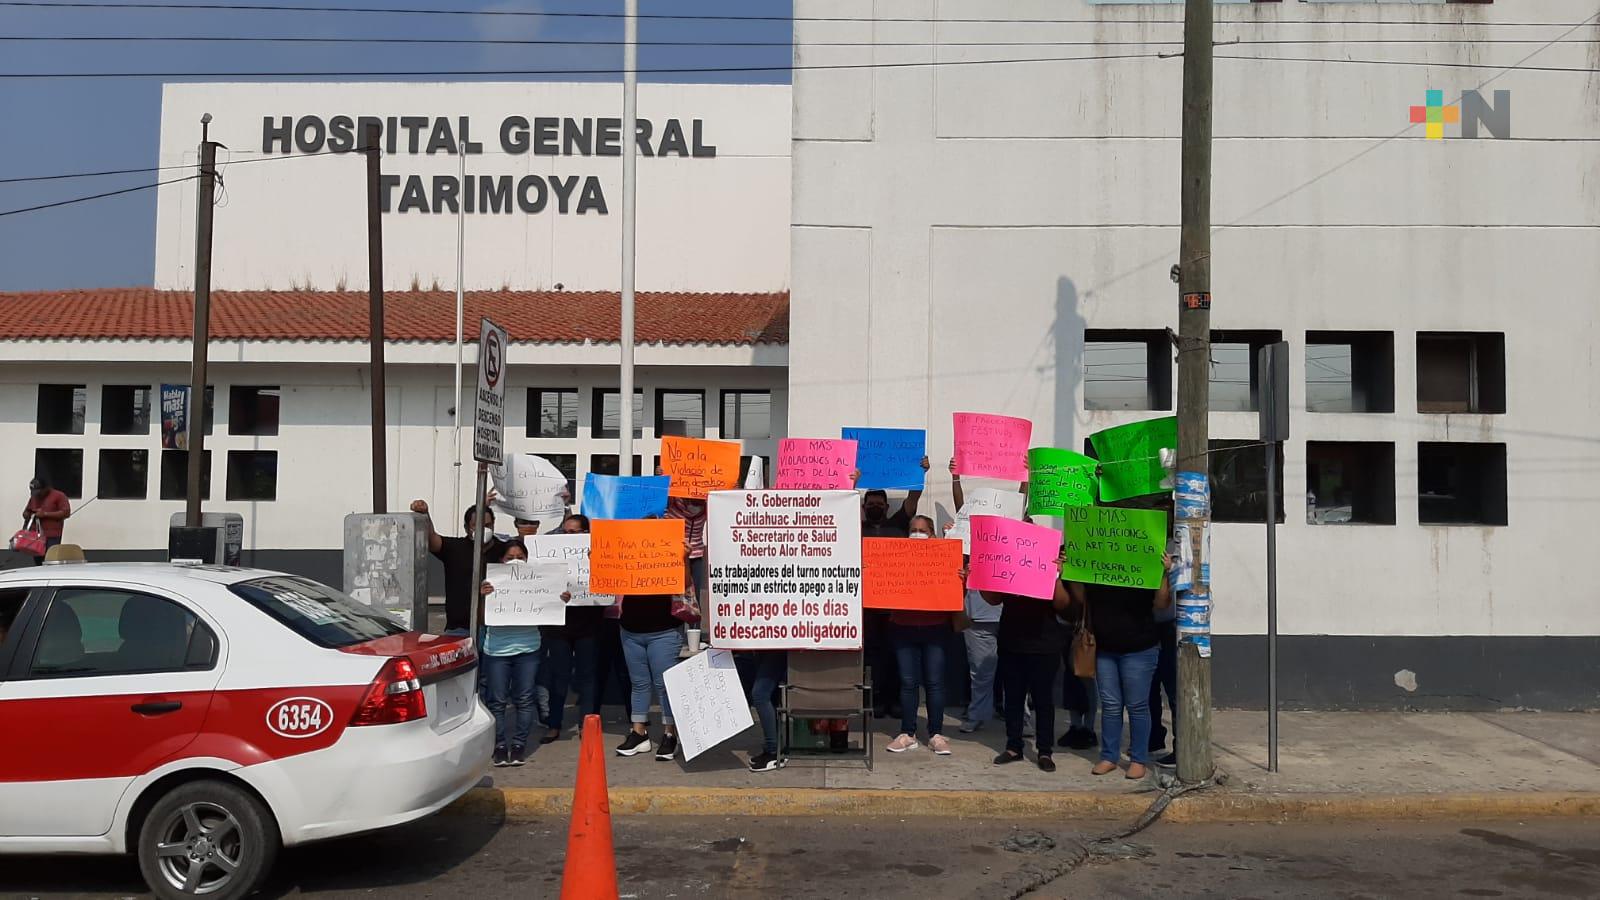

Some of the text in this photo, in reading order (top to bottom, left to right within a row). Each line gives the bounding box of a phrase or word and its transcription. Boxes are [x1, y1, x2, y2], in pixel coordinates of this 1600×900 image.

[262, 114, 716, 158] HOSPITAL GENERAL
[379, 173, 609, 215] TARIMOYA
[478, 407, 501, 427] DESCENSO
[477, 426, 500, 444] HOSPITAL
[667, 440, 682, 460] No
[697, 444, 707, 462] la
[783, 440, 795, 453] NO
[780, 455, 829, 467] VIOLACIONES
[836, 457, 849, 466] AL
[812, 468, 824, 477] DE
[828, 468, 839, 477] LA
[745, 493, 822, 508] Sr. Gobernador
[735, 511, 835, 526] Cuitlahuac Jiménez
[1070, 507, 1088, 522] NO
[732, 529, 837, 543] Sr. Secretario de Salud
[976, 522, 1038, 551] Nadie por
[1086, 527, 1149, 540] VIOLACIONES
[534, 539, 558, 559] La
[740, 543, 832, 557] Roberto Alor Ramos
[1085, 541, 1104, 551] ART
[1125, 543, 1138, 553] DE
[1143, 545, 1155, 553] LA
[978, 552, 1047, 571] encima de la
[1070, 557, 1087, 568] LEY
[1130, 564, 1143, 574] DE
[709, 564, 723, 578] Los
[724, 564, 779, 581] trabajadores
[781, 564, 795, 578] del
[797, 564, 820, 578] turno
[821, 565, 861, 578] nocturno
[992, 563, 1016, 584] Ley
[1093, 573, 1145, 586] TRABAJO
[712, 580, 749, 597] exigimos
[750, 582, 762, 594] un
[763, 580, 797, 594] estricto
[799, 583, 826, 597] apego
[827, 583, 834, 594] a
[835, 580, 844, 594] la
[845, 580, 859, 597] ley
[717, 598, 849, 621] en el pago de los días
[714, 620, 858, 643] de descanso obligatorio
[277, 702, 322, 731] 6354
